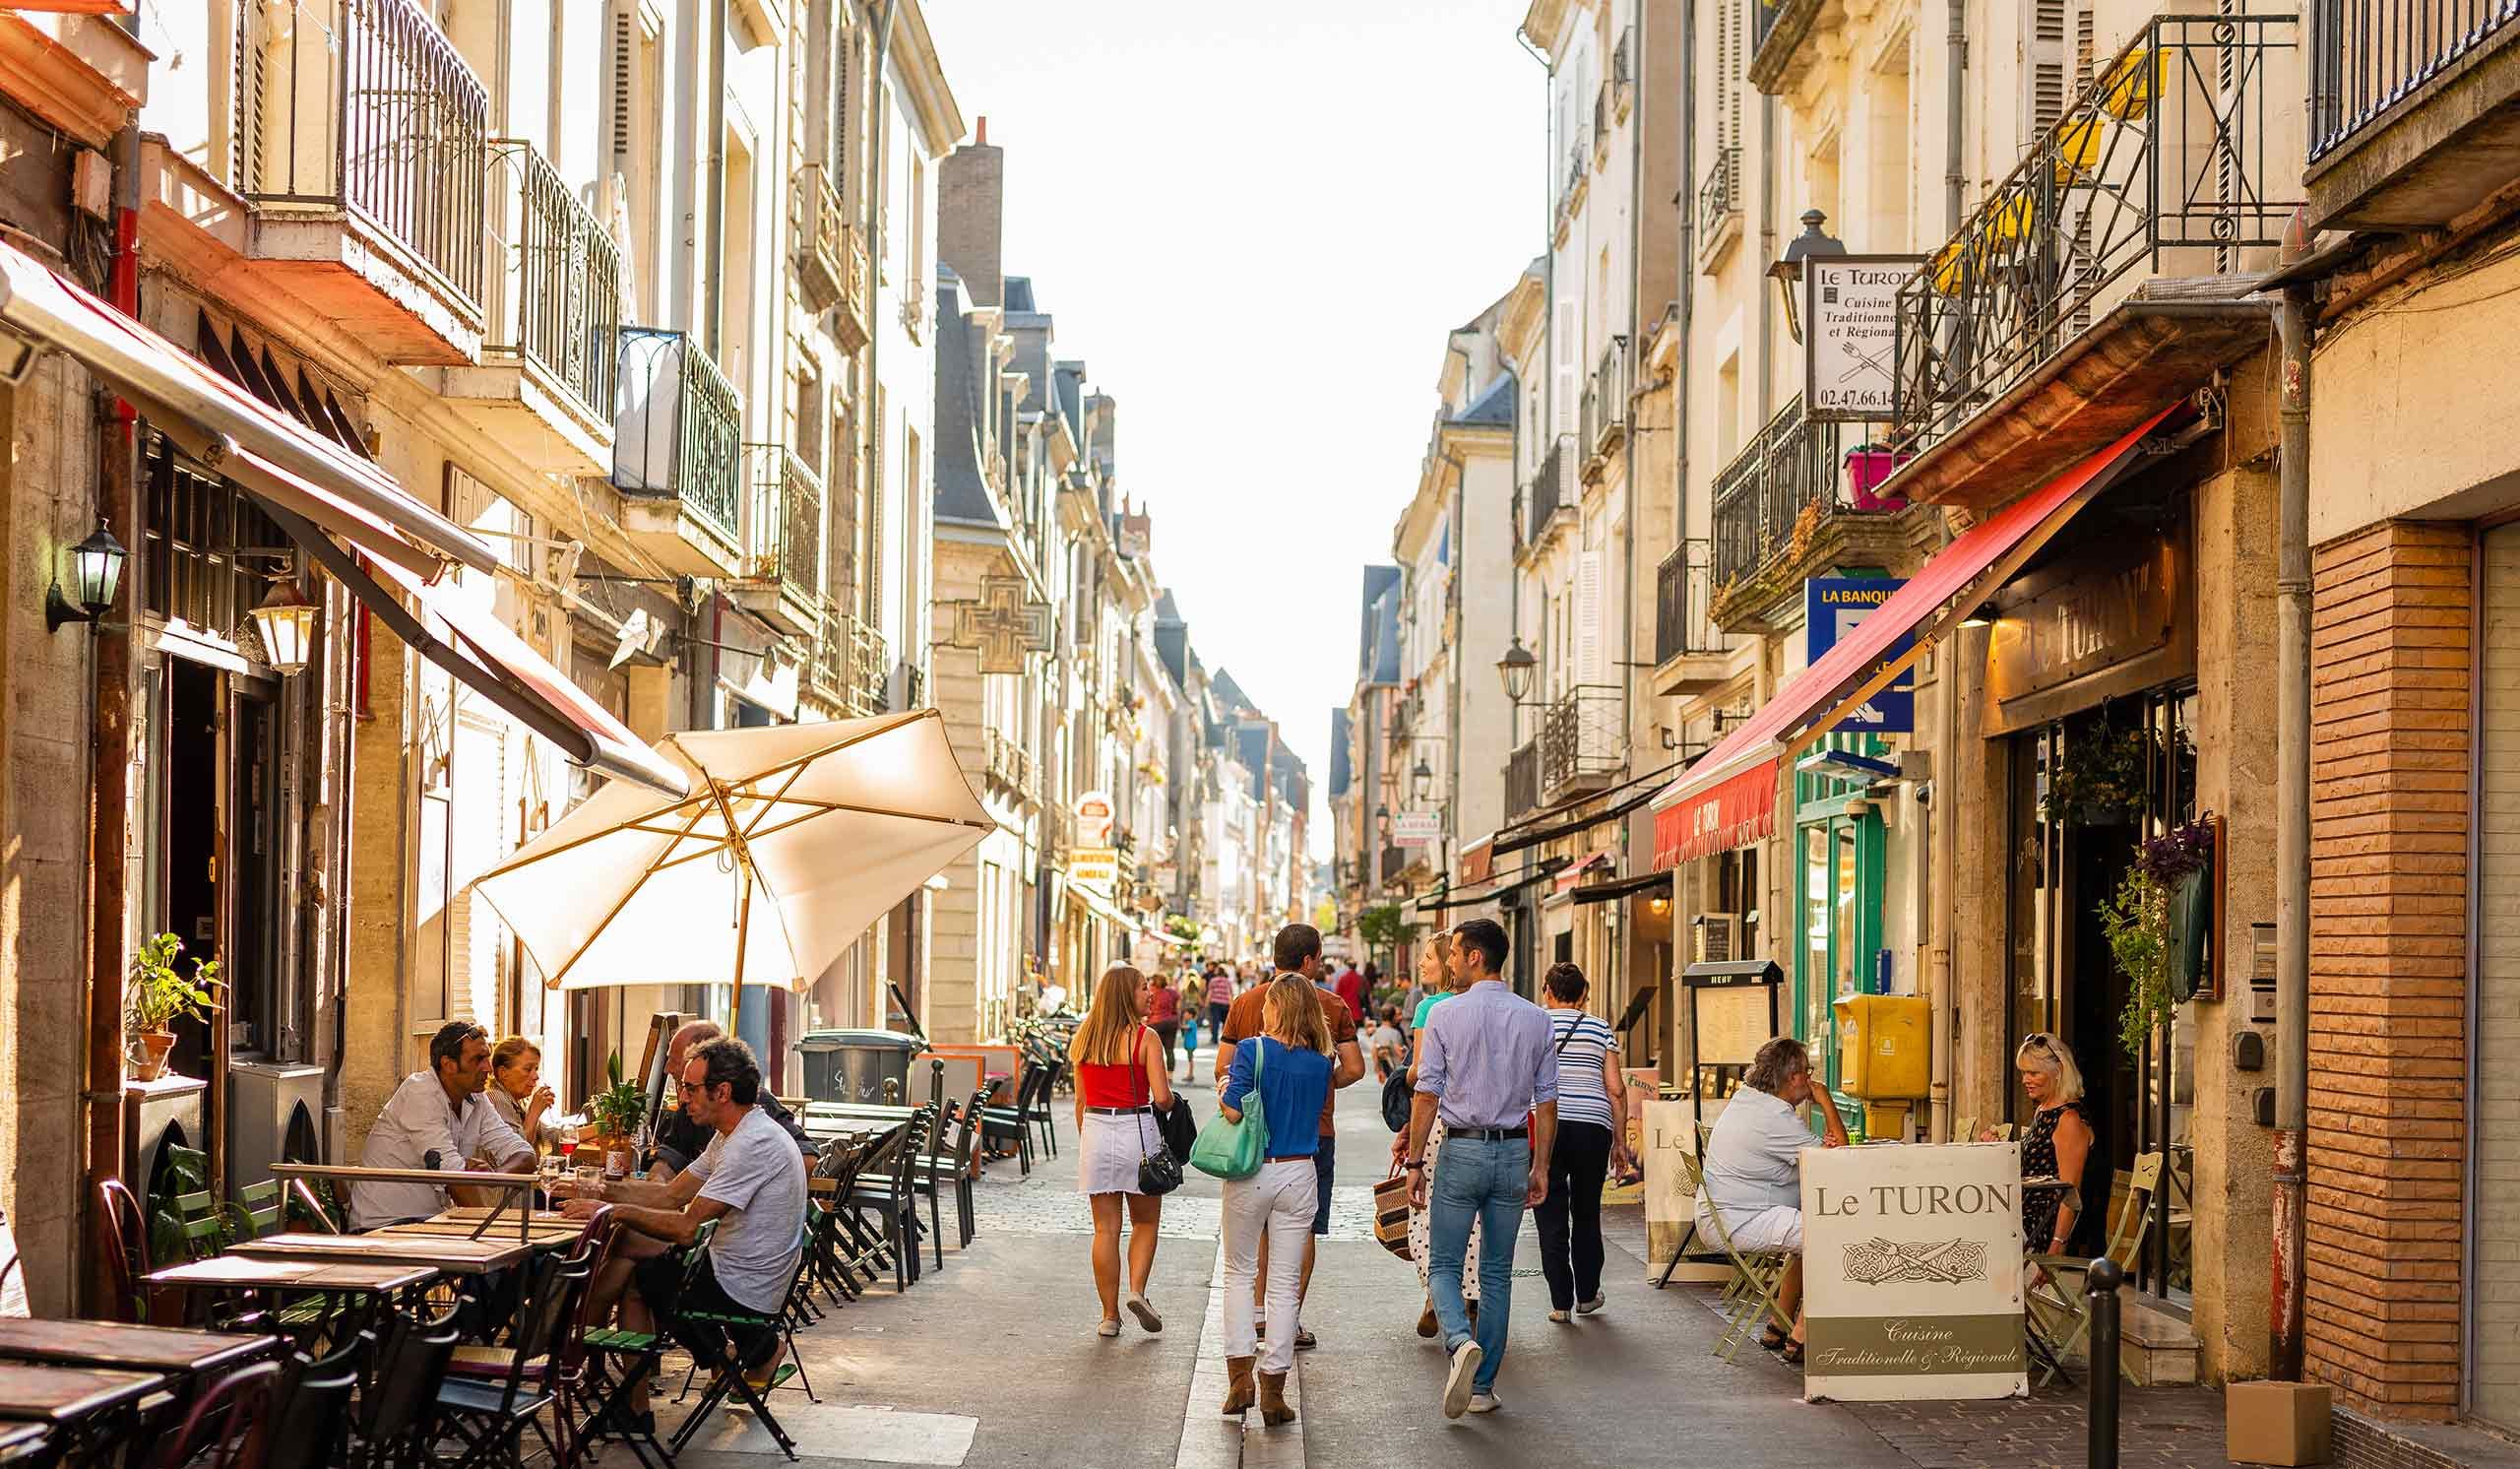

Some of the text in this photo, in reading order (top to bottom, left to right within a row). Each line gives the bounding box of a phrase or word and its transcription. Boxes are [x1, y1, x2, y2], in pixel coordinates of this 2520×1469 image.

[1844, 297, 1892, 308] Cuisine
[1825, 311, 1896, 323] Traditionne
[1829, 327, 1906, 339] et Régiona
[1820, 390, 1917, 406] 02.47.66.142
[1822, 591, 1894, 604] LA BANQU
[1654, 1128, 1685, 1149] Le
[1815, 1183, 2013, 1216] Le TURON
[1883, 1318, 1953, 1342] Cuisine
[1941, 1345, 2020, 1370] Régionale
